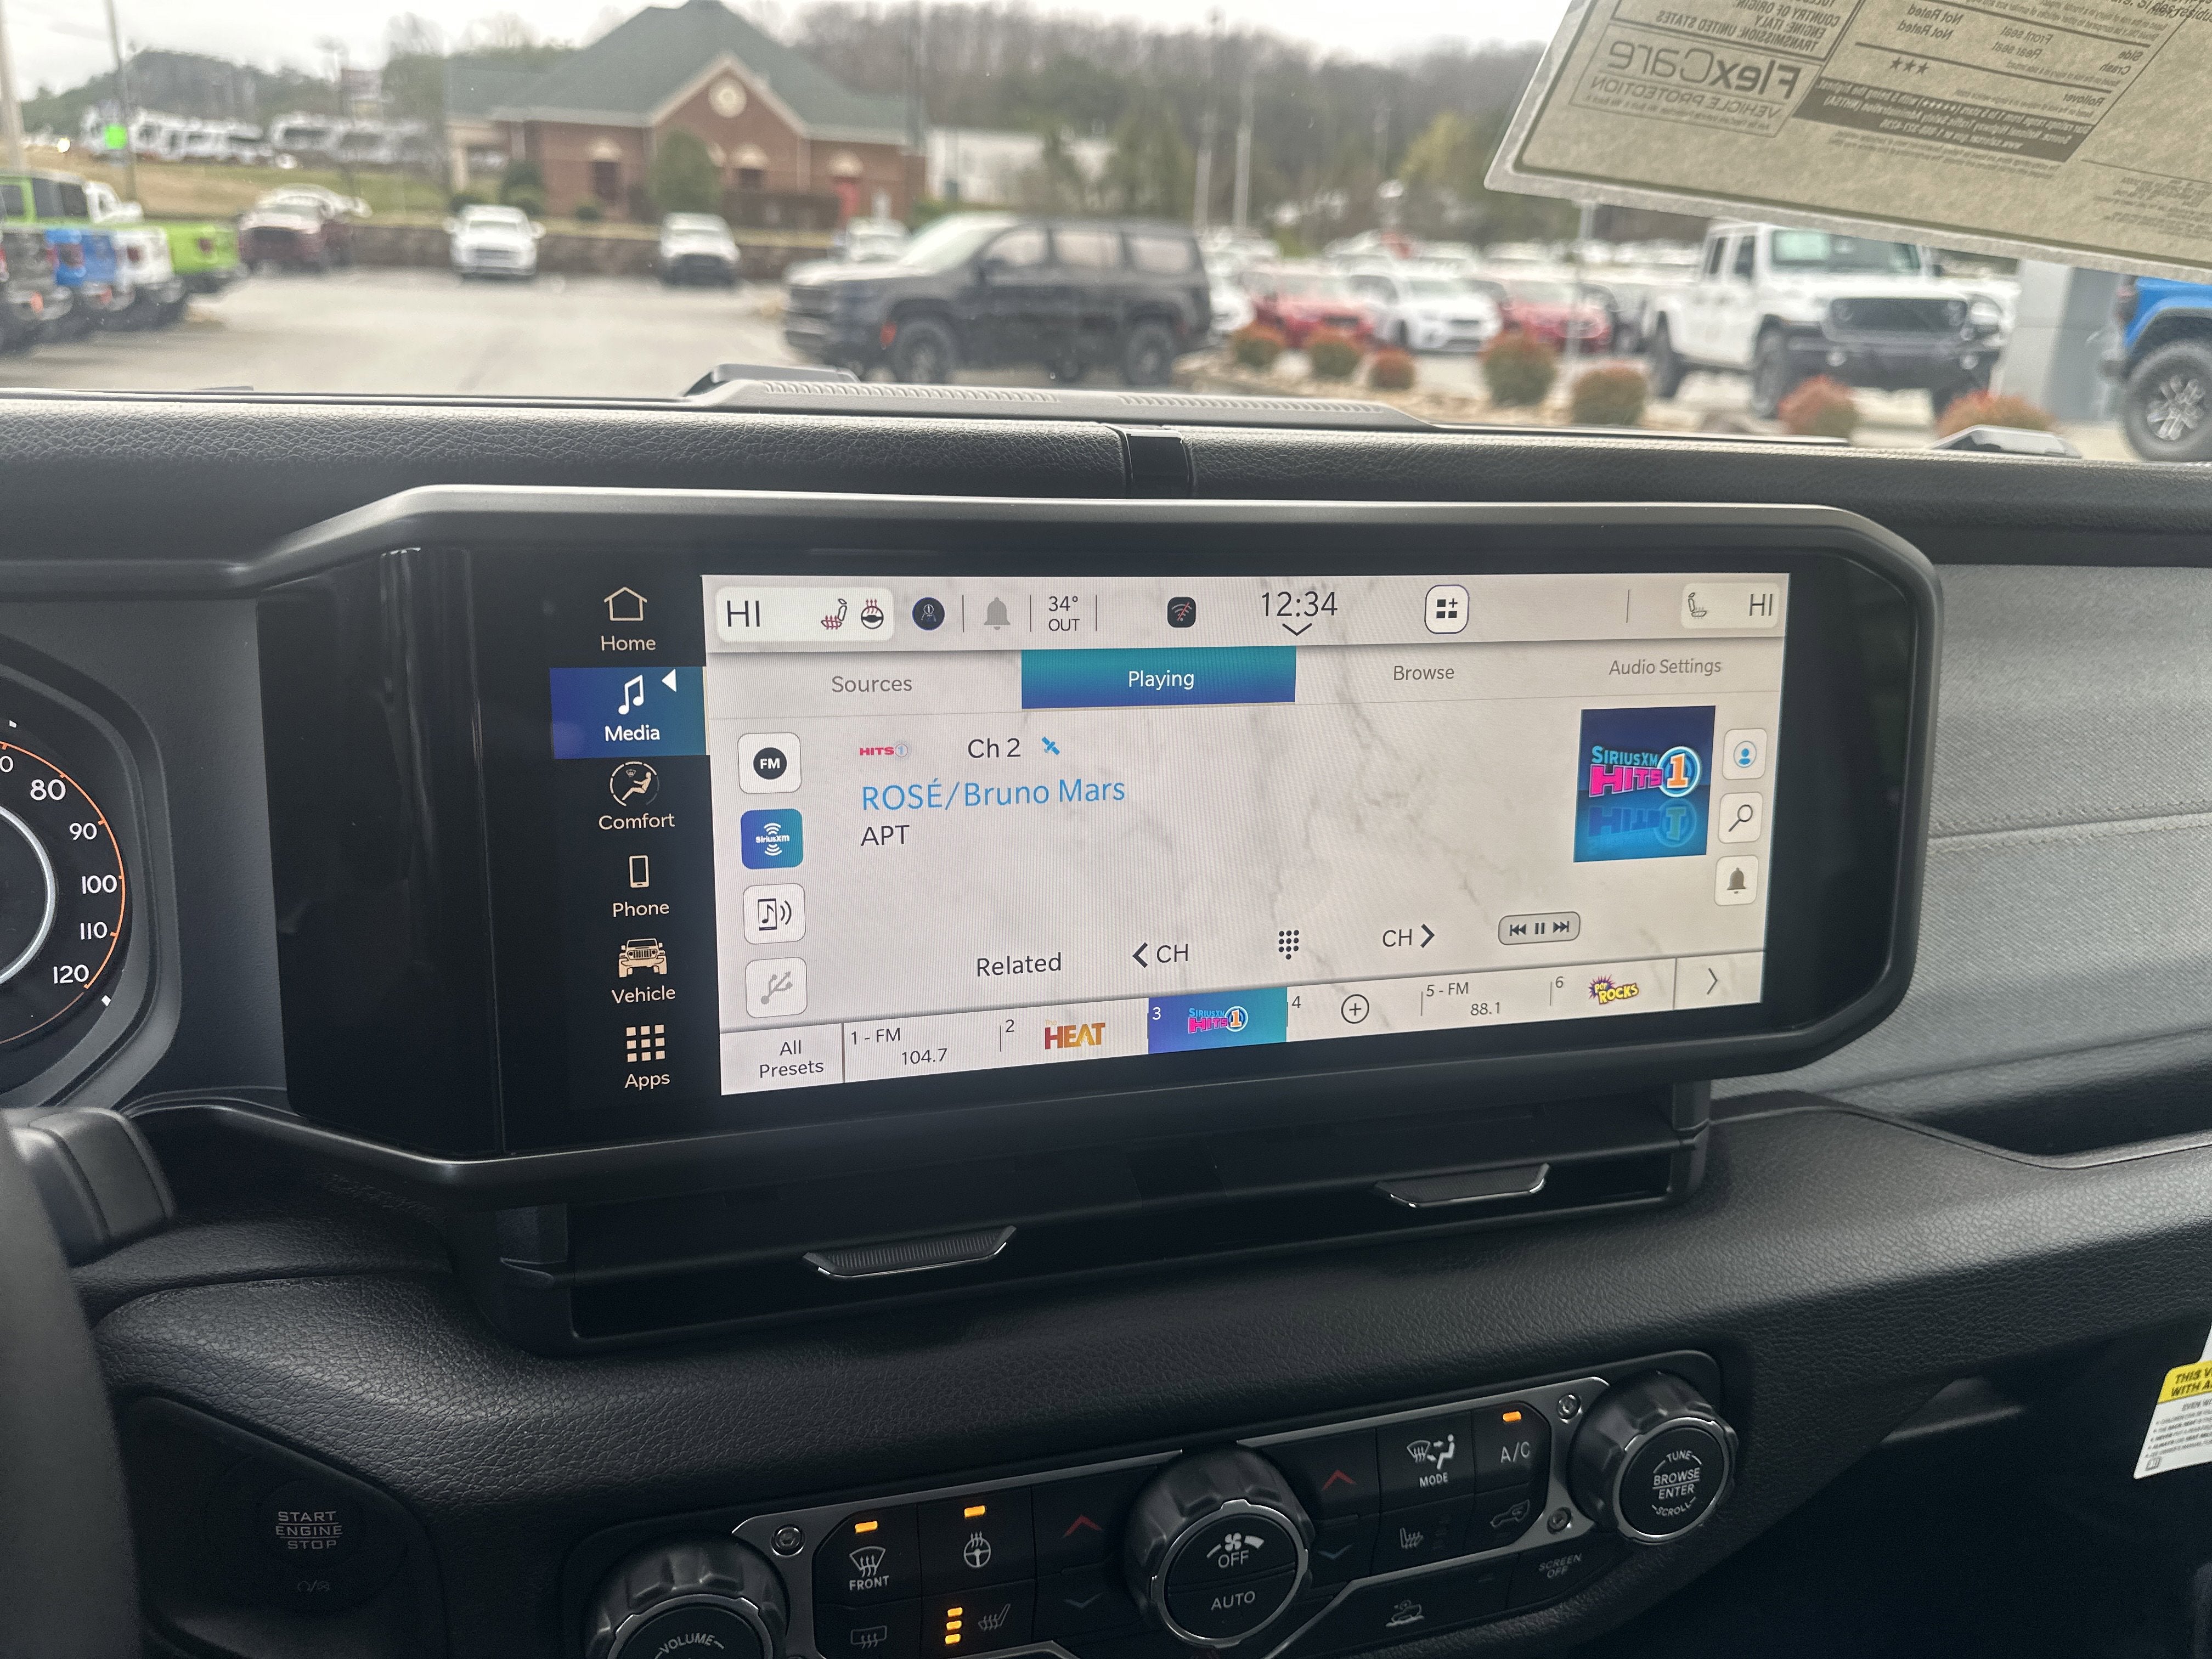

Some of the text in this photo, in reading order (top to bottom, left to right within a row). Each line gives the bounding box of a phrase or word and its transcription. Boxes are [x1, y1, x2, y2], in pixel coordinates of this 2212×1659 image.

[1048, 595, 1079, 613] 34°
[1261, 591, 1339, 617] 12:34
[1749, 593, 1773, 617] HI
[726, 600, 760, 628] HI
[1048, 618, 1080, 631] OUT
[601, 635, 656, 651] Home
[1393, 665, 1455, 681] Browse
[1609, 658, 1722, 676] Audio Settings
[832, 675, 912, 692] Sources
[1128, 670, 1195, 690] Playing
[605, 724, 661, 742] Media
[968, 737, 1020, 758] Ch 2
[760, 758, 780, 769] FM
[1589, 753, 1689, 798] HITS 1
[30, 779, 66, 800] 80
[863, 778, 1125, 811] ROSÉ/Bruno Mars
[599, 813, 675, 830] Comfort
[69, 822, 98, 840] 90
[861, 824, 910, 847] APT
[82, 874, 117, 894] 100
[612, 901, 670, 917] Phone
[80, 921, 108, 940] 110
[1382, 928, 1413, 947] CH
[1156, 943, 1189, 963] CH
[977, 952, 1063, 977] Related
[53, 964, 89, 984] 120
[1555, 977, 1564, 989] 6
[611, 985, 676, 1004] Vehicle
[1449, 982, 1469, 996] FM
[1598, 983, 1639, 1005] ROCKS
[1291, 996, 1302, 1009] 4
[1470, 1002, 1500, 1015] 88.1
[1152, 1007, 1161, 1020] 3
[1005, 1019, 1015, 1033] 2
[876, 1028, 901, 1043] FM
[1045, 1022, 1106, 1049] HEAT
[779, 1039, 802, 1056] All
[901, 1048, 948, 1065] 104.7
[759, 1059, 825, 1079] Presets
[624, 1073, 670, 1091] Apps
[1500, 1441, 1531, 1464] A/C
[1666, 1450, 1692, 1463] TUNE
[1419, 1471, 1449, 1488] MODE
[1653, 1467, 1700, 1486] BROWSE
[1658, 1483, 1695, 1500] ENTER
[278, 1511, 337, 1522] START
[1656, 1502, 1692, 1517] SCROLL
[275, 1525, 343, 1536] ENGINE
[287, 1540, 337, 1550] STOP
[1217, 1550, 1250, 1569] OFF
[1538, 1553, 1583, 1572] SCREEN
[1547, 1567, 1568, 1579] OFF
[849, 1575, 890, 1591] FRONT
[1211, 1591, 1256, 1610] AUTO
[659, 1632, 716, 1655] VOLUME
